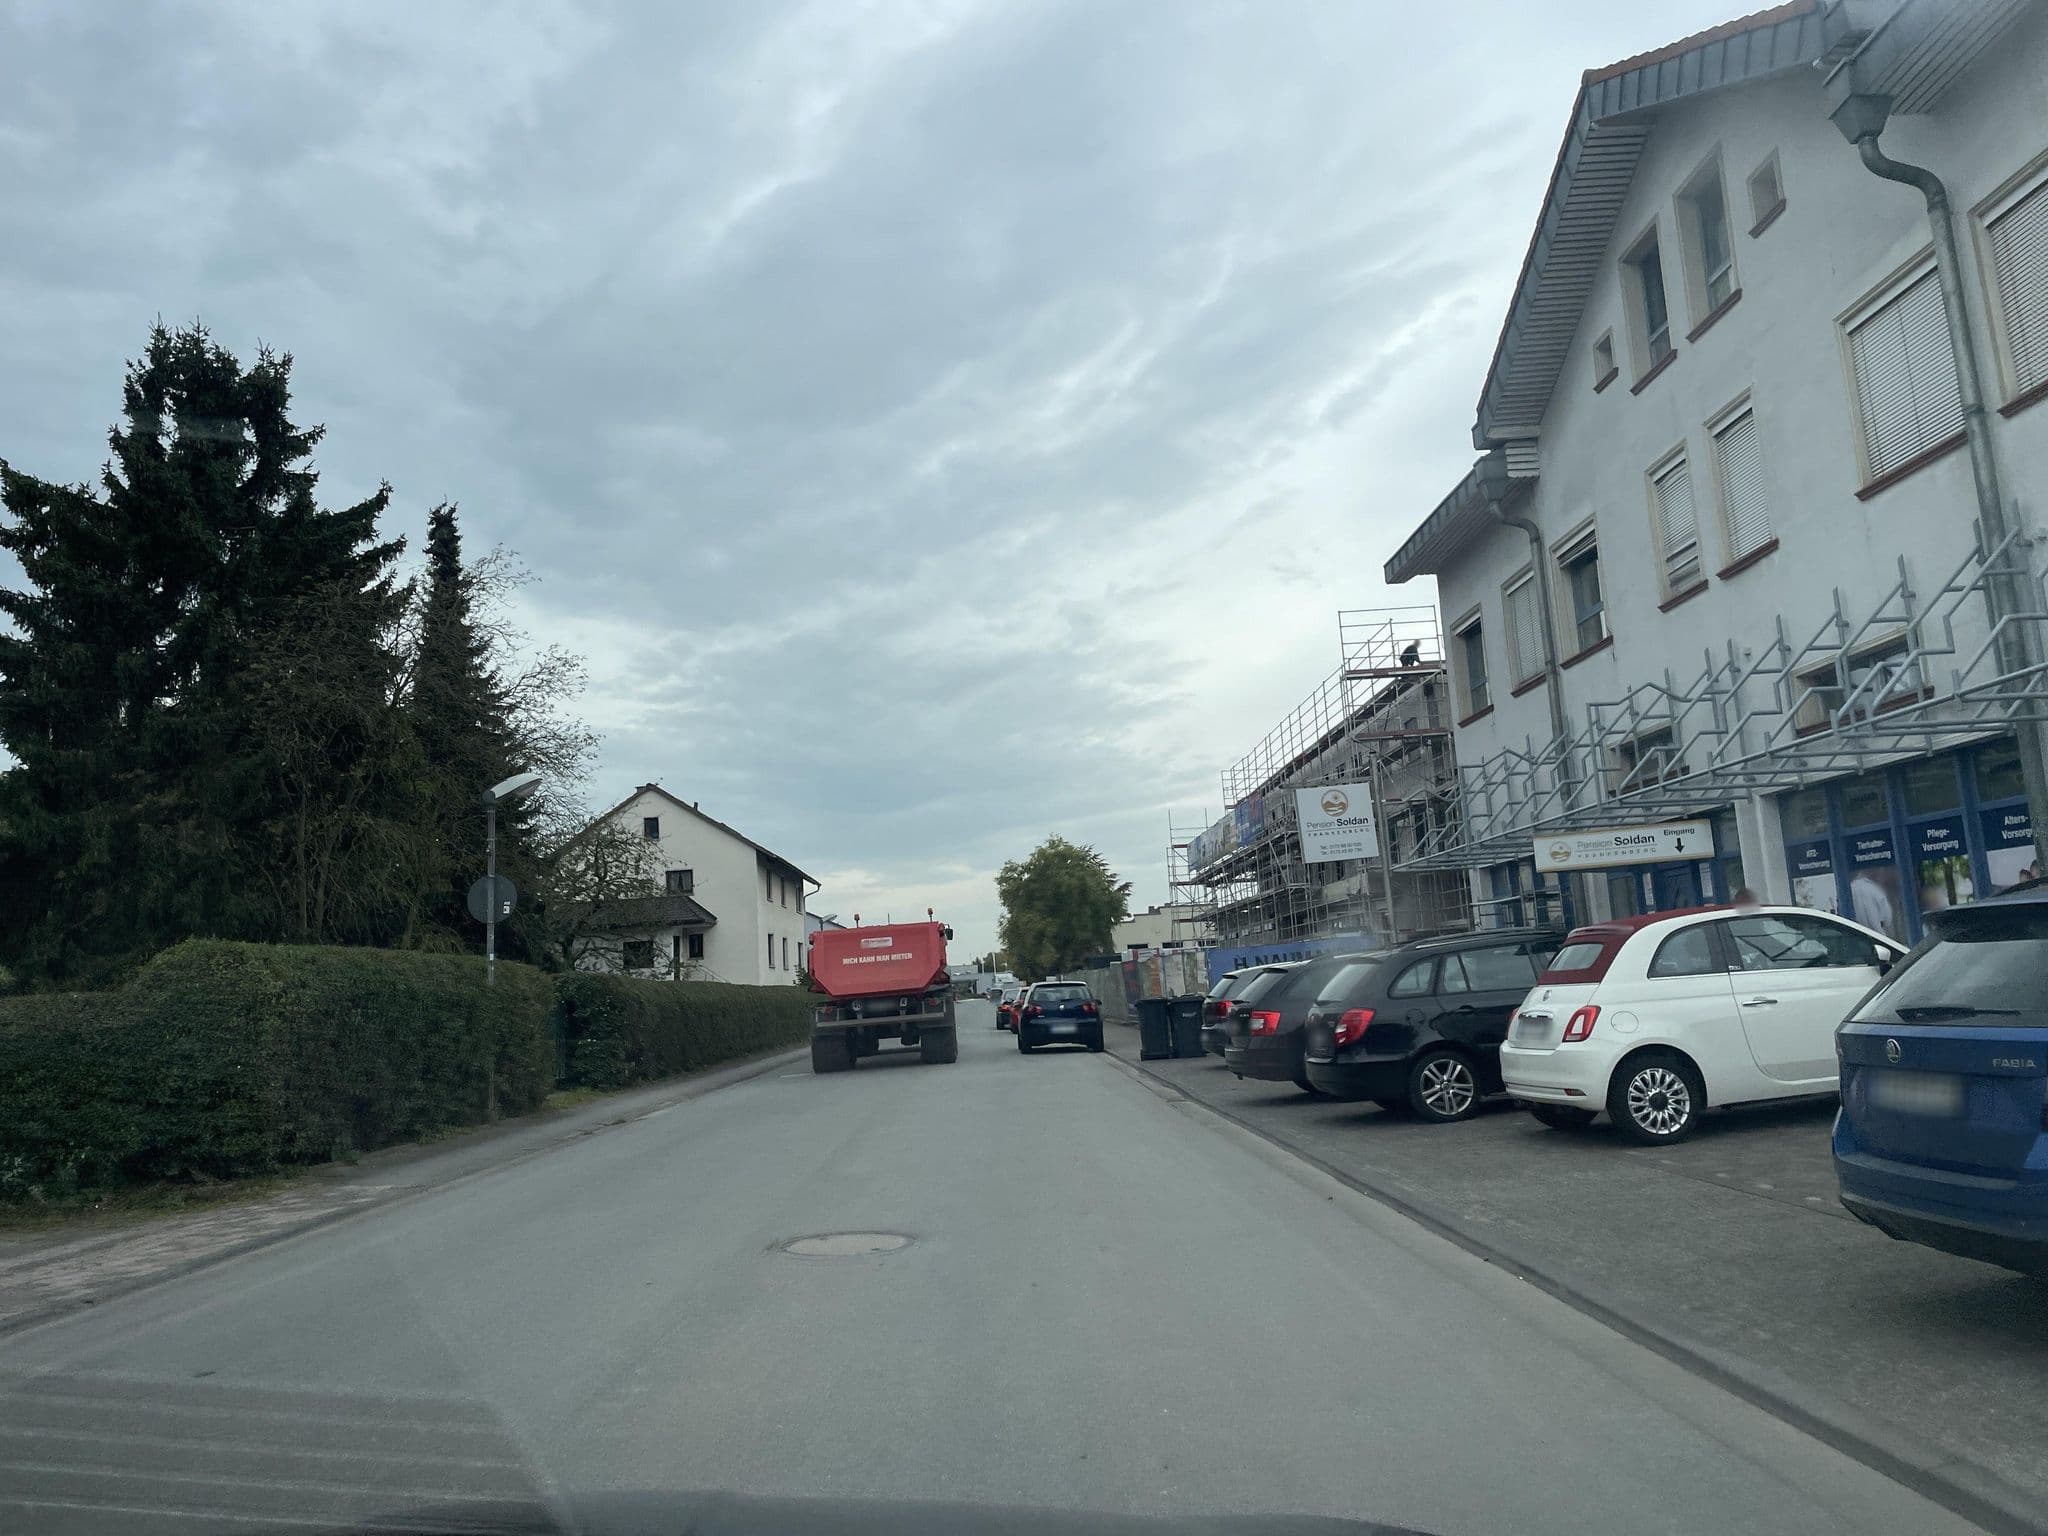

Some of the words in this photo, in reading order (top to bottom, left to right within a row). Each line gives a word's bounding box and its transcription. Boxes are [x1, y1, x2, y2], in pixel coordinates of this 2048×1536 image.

[1336, 817, 1369, 827] Soldan
[1663, 827, 1695, 837] Eingang
[1926, 829, 1950, 839] Pflege-
[1614, 834, 1655, 847] Soldan
[1992, 1058, 2037, 1068] FABIA
